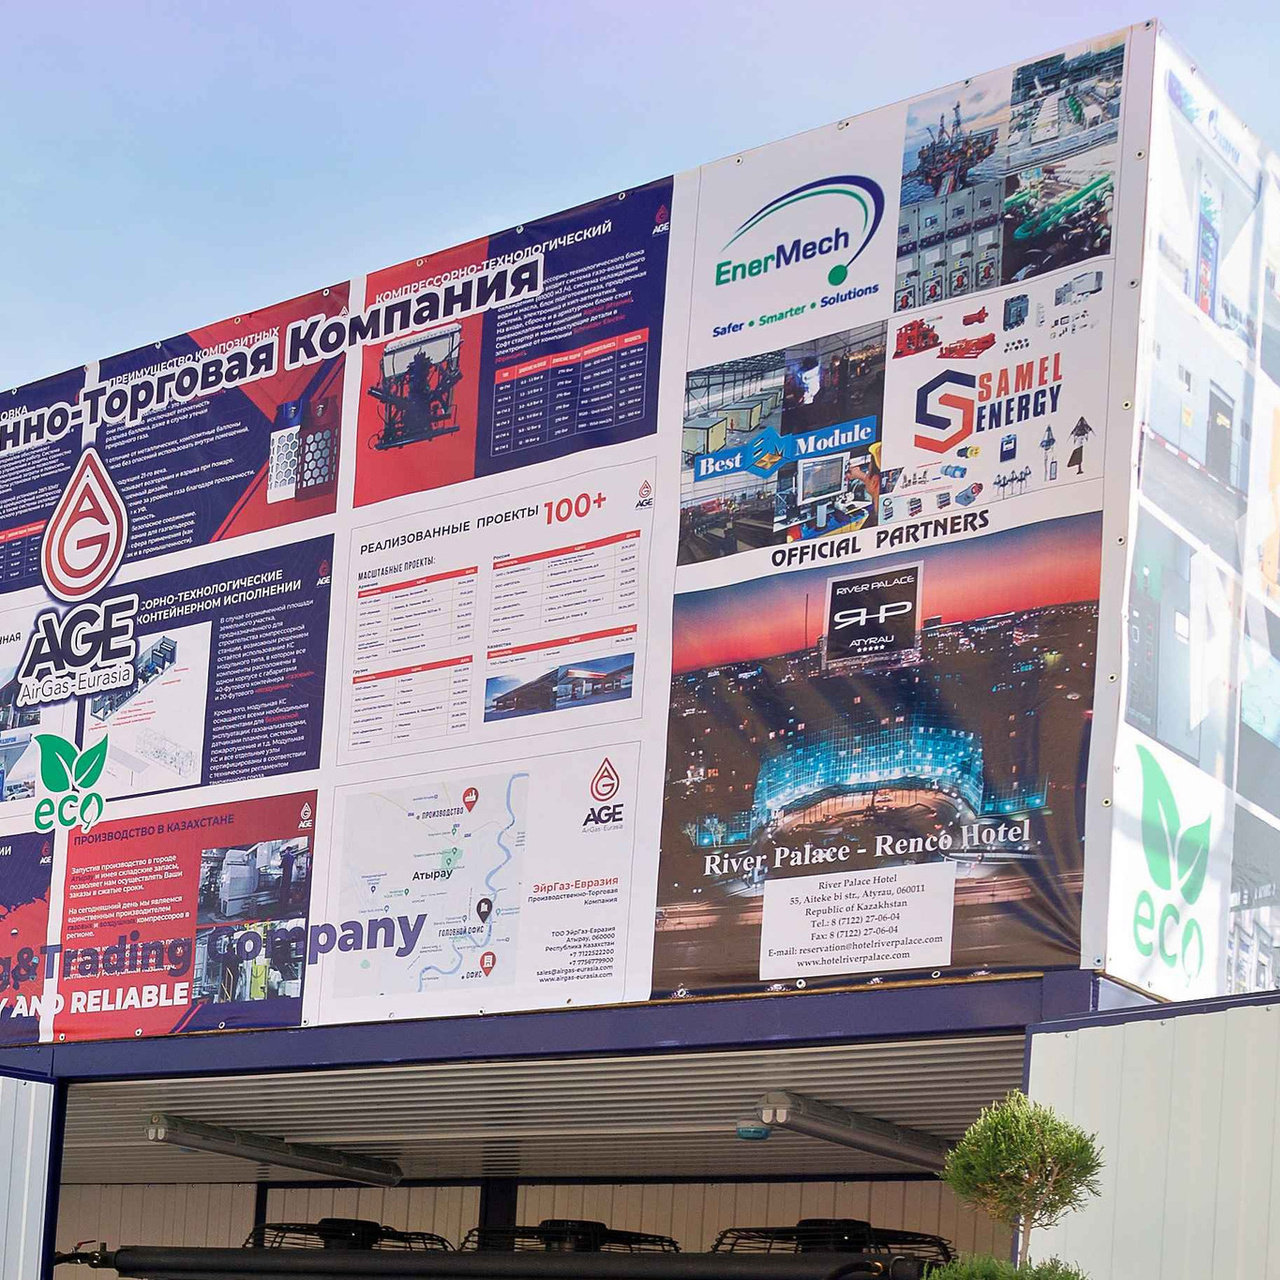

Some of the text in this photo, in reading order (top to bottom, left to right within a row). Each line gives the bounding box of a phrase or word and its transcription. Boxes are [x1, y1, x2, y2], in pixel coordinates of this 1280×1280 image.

[652, 221, 670, 236] AGE
[715, 227, 849, 286] EnerMech
[286, 256, 541, 368] Компания
[712, 283, 879, 337] Safer Smarter Solutions
[108, 326, 280, 385] ПРЕИМУЩЕСТВО КОМПОЗИТНЫХ
[978, 352, 1062, 402] SAMEL
[976, 384, 1062, 432] ENERGY
[699, 424, 872, 477] Best Module
[635, 498, 653, 510] AGE
[360, 492, 607, 555] РЕАЛИЗОВАННЫЕ ПРОЕКТЫ 100+
[771, 510, 990, 568] OFFICIAL PARTNERS
[358, 556, 436, 580] МАСШТАБНЫЕ ПРОЕКТЫ:
[316, 576, 331, 586] AGE
[836, 575, 915, 596] RIVER PALACE
[137, 579, 302, 625] КОНТЕЙНЕРНОМ ИСПОЛНЕНИИ
[22, 599, 135, 678] AGE
[849, 635, 894, 648] ATYRAU
[20, 667, 130, 702] AirGas-Eurasia
[34, 793, 103, 830] eco
[422, 807, 464, 819] ПРОИЗВОДСТВО
[582, 804, 624, 827] AGE
[74, 814, 234, 846] ПРОИЗВОДСТВО В КАЗАХСТАНЕ
[298, 820, 313, 828] AGE
[703, 819, 1031, 876] River Palace Renco Hotel
[39, 856, 52, 864] AGE
[412, 868, 453, 881] Атырау
[533, 877, 619, 894] ЭйрГаз-Евразия
[819, 874, 897, 890] River Palace Hotel
[584, 897, 617, 905] Компания
[803, 894, 831, 904] Aiteke
[833, 892, 842, 900] bi
[862, 888, 895, 900] Atyrau,
[896, 884, 925, 895] 060011
[805, 899, 908, 918] Republic of Kazakhstan
[831, 918, 836, 926] 8
[838, 916, 863, 926] (7122)
[865, 912, 900, 922] 27-06-04
[829, 931, 835, 939] 8
[836, 929, 861, 939] (7122)
[863, 926, 898, 936] 27-06-04
[1133, 890, 1204, 987] eco
[768, 947, 798, 957] E-mail:
[797, 951, 910, 968] www.hotelriverpalace.com
[466, 970, 482, 979] ОФИС
[11, 991, 64, 1018] AND
[70, 982, 189, 1014] RELIABLE
